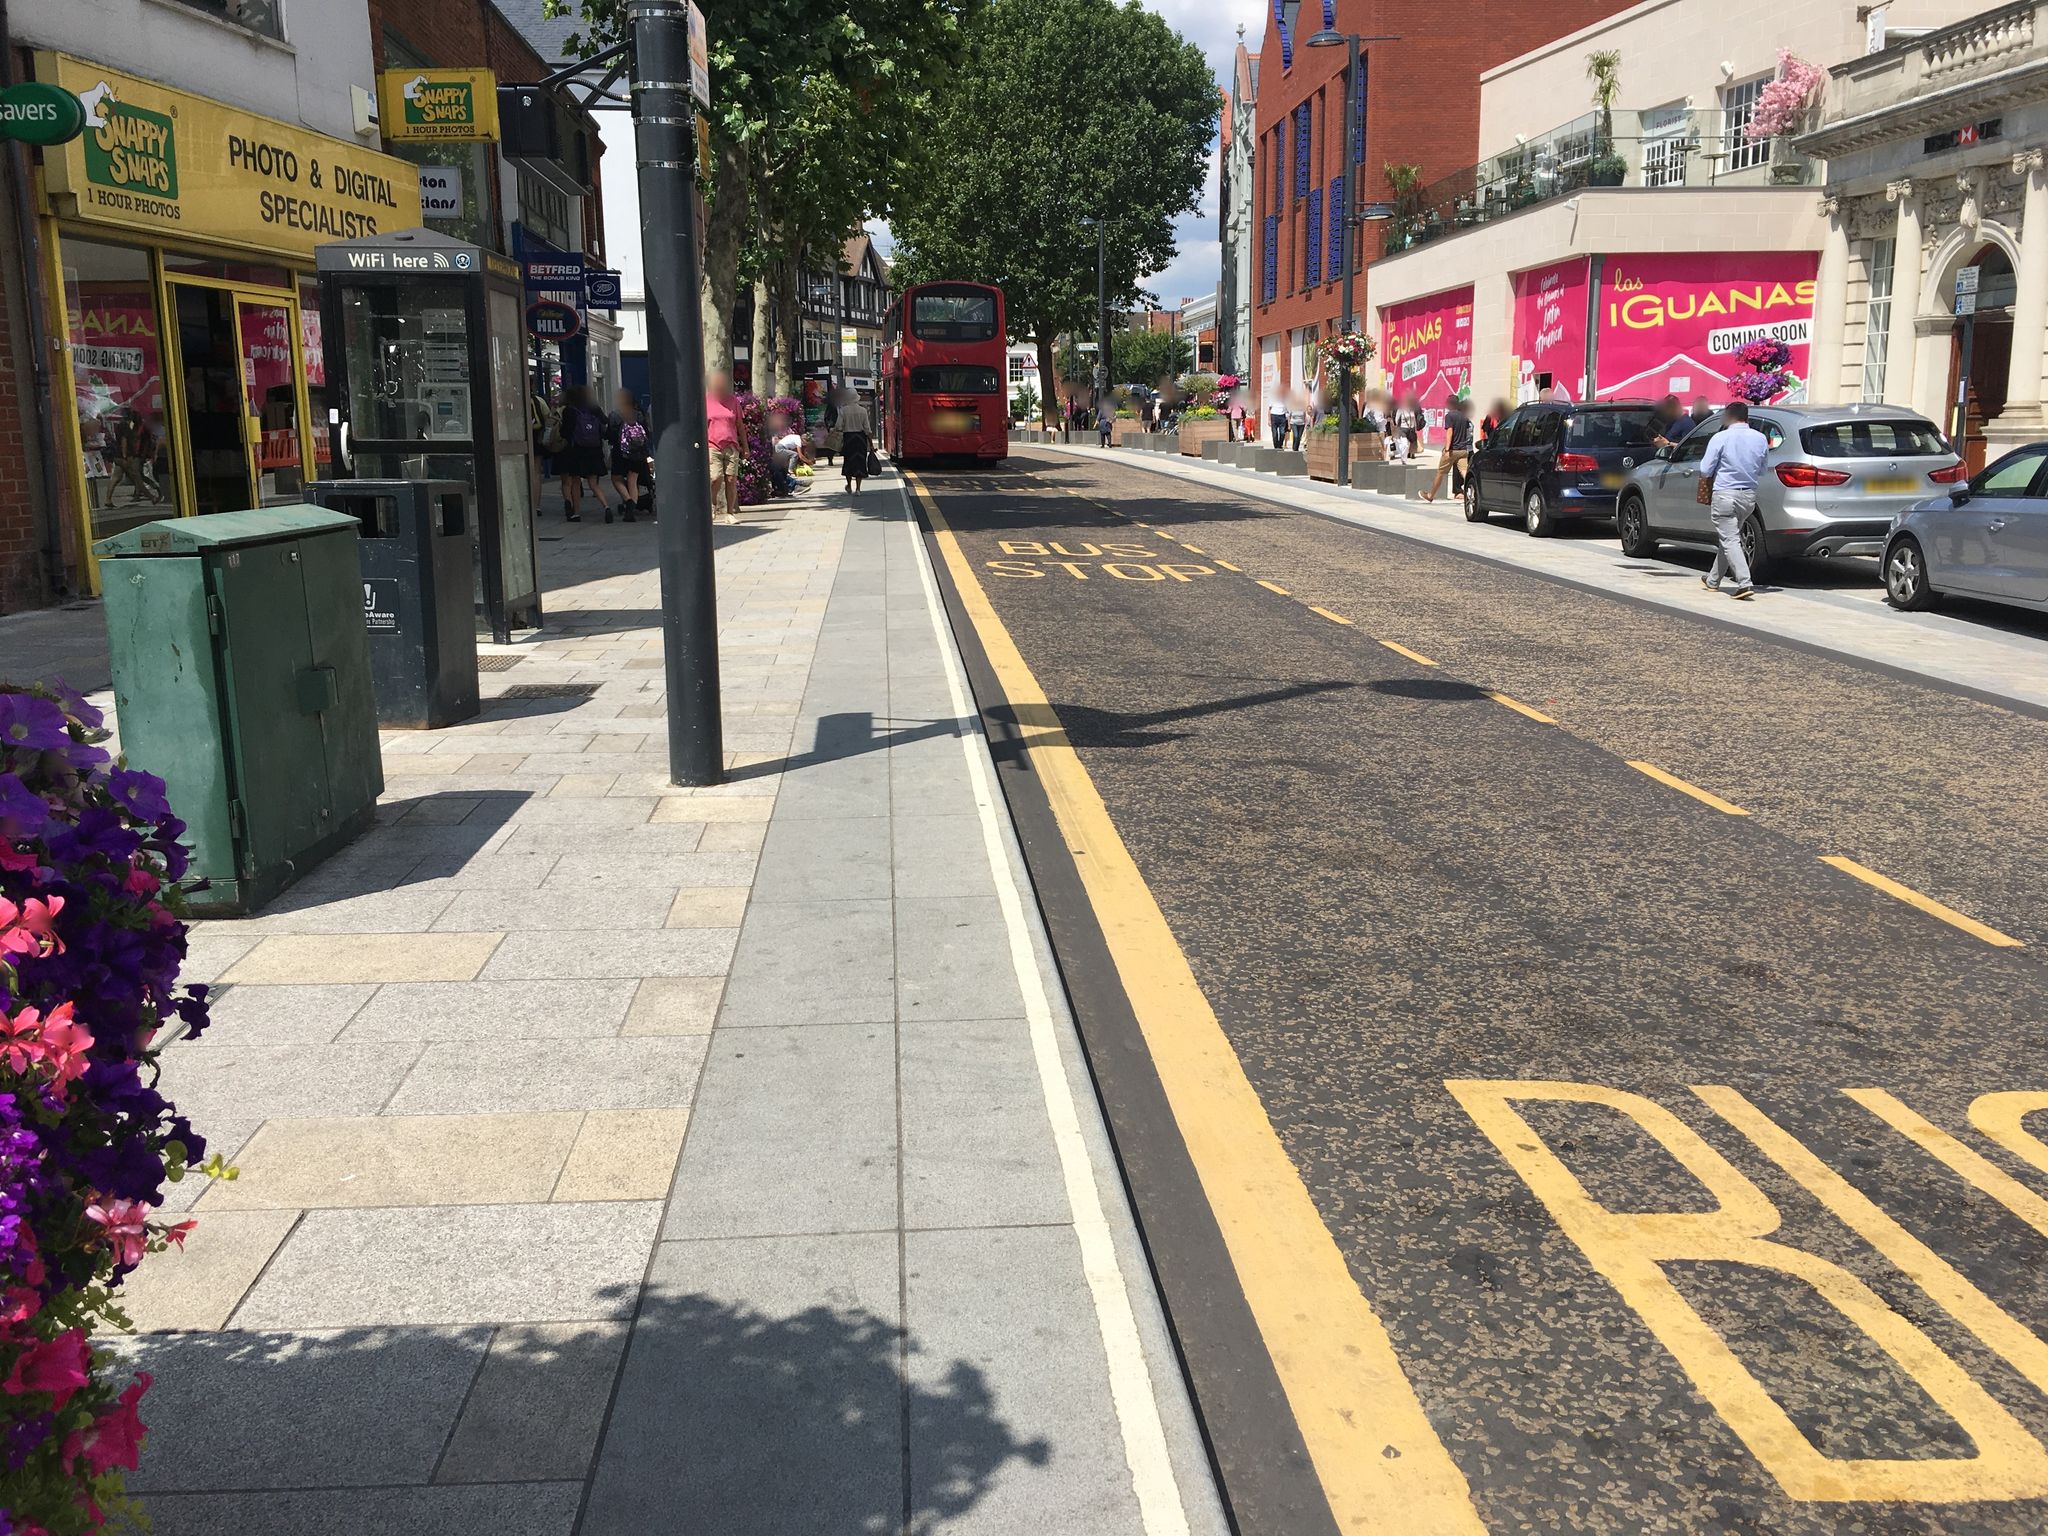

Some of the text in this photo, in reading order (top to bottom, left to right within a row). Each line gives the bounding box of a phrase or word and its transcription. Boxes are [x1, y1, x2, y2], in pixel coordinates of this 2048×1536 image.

[413, 85, 467, 108] SNAPPY
[422, 104, 467, 121] SNAPS
[94, 101, 168, 159] SNAPPY
[412, 126, 438, 134] HOUR
[439, 125, 475, 134] PHOTOS
[109, 146, 170, 192] SNAPS
[228, 134, 398, 209] PHOTO & DIGITAL
[87, 187, 181, 220] 1 HOUR PHOTOS
[260, 190, 378, 240] SPECIALISTS
[347, 252, 429, 268] WiFi here
[529, 264, 581, 275] BETFRED
[1613, 267, 1644, 292] las
[1610, 279, 1817, 330] IGUANAS
[536, 319, 567, 333] HILL
[1712, 322, 1808, 352] COMING SOON
[1386, 316, 1443, 364] IGUANAS
[997, 540, 1158, 558] BUS
[985, 561, 1217, 582] STOP
